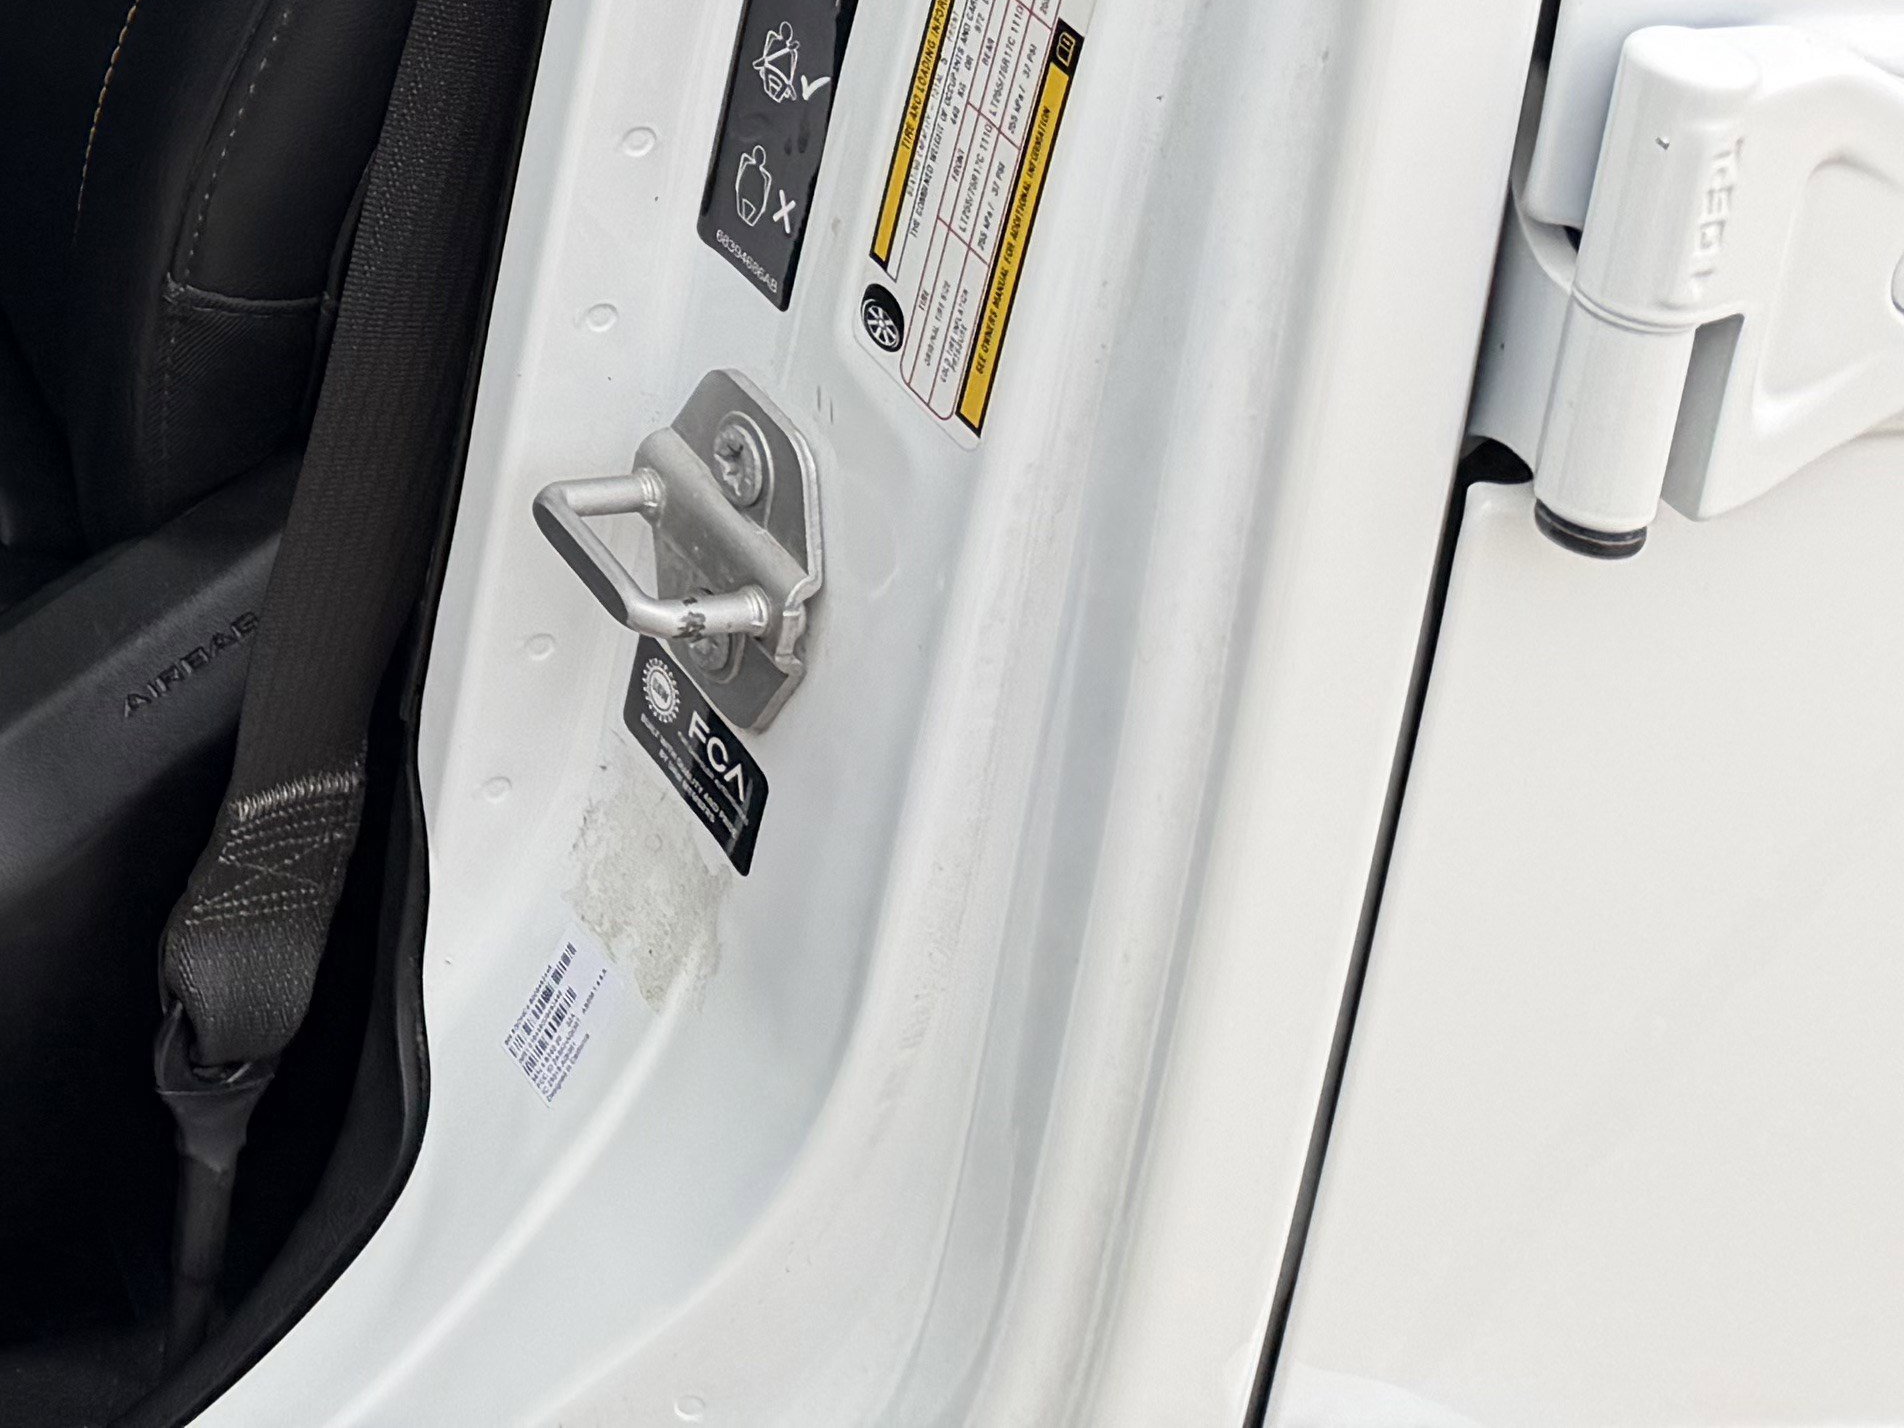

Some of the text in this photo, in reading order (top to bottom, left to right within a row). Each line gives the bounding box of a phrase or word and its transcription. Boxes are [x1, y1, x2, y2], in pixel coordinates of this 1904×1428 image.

[901, 120, 915, 151] TIRE
[908, 92, 922, 122] AND
[915, 37, 936, 94] LOADING
[688, 710, 745, 803] FCA
